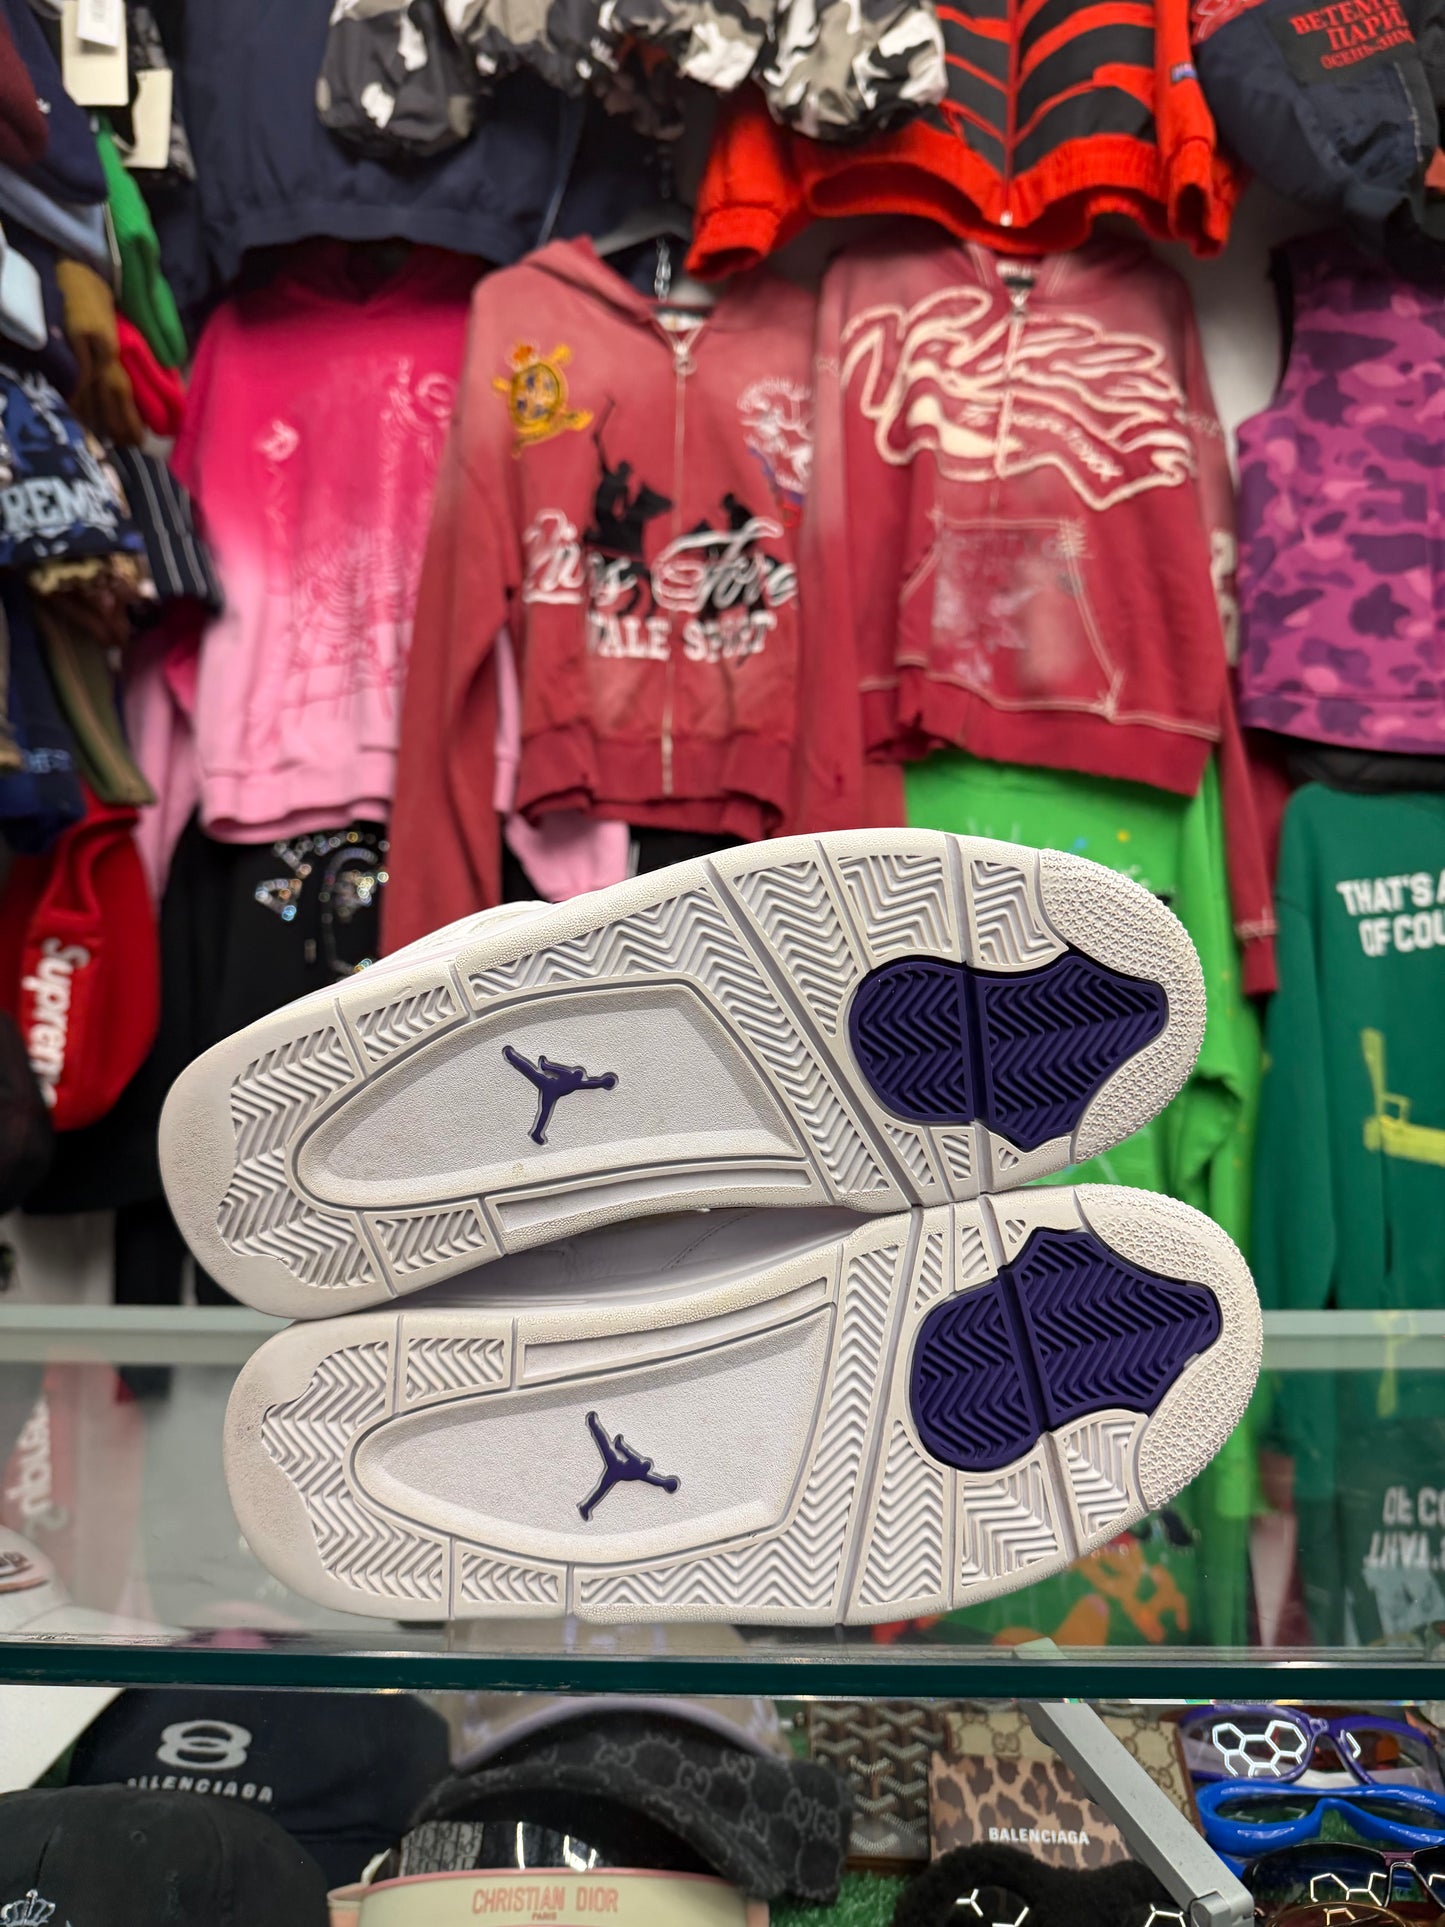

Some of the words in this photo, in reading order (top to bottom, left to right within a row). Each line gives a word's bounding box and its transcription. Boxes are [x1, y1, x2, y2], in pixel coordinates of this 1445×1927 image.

[1336, 871, 1433, 916] THAT'S
[1359, 917, 1390, 957] OF
[988, 1826, 1091, 1846] BALENCIAGA
[472, 1885, 565, 1915] CHRISTIAN
[575, 1886, 619, 1913] DIOR
[531, 1911, 558, 1921] PARIS
